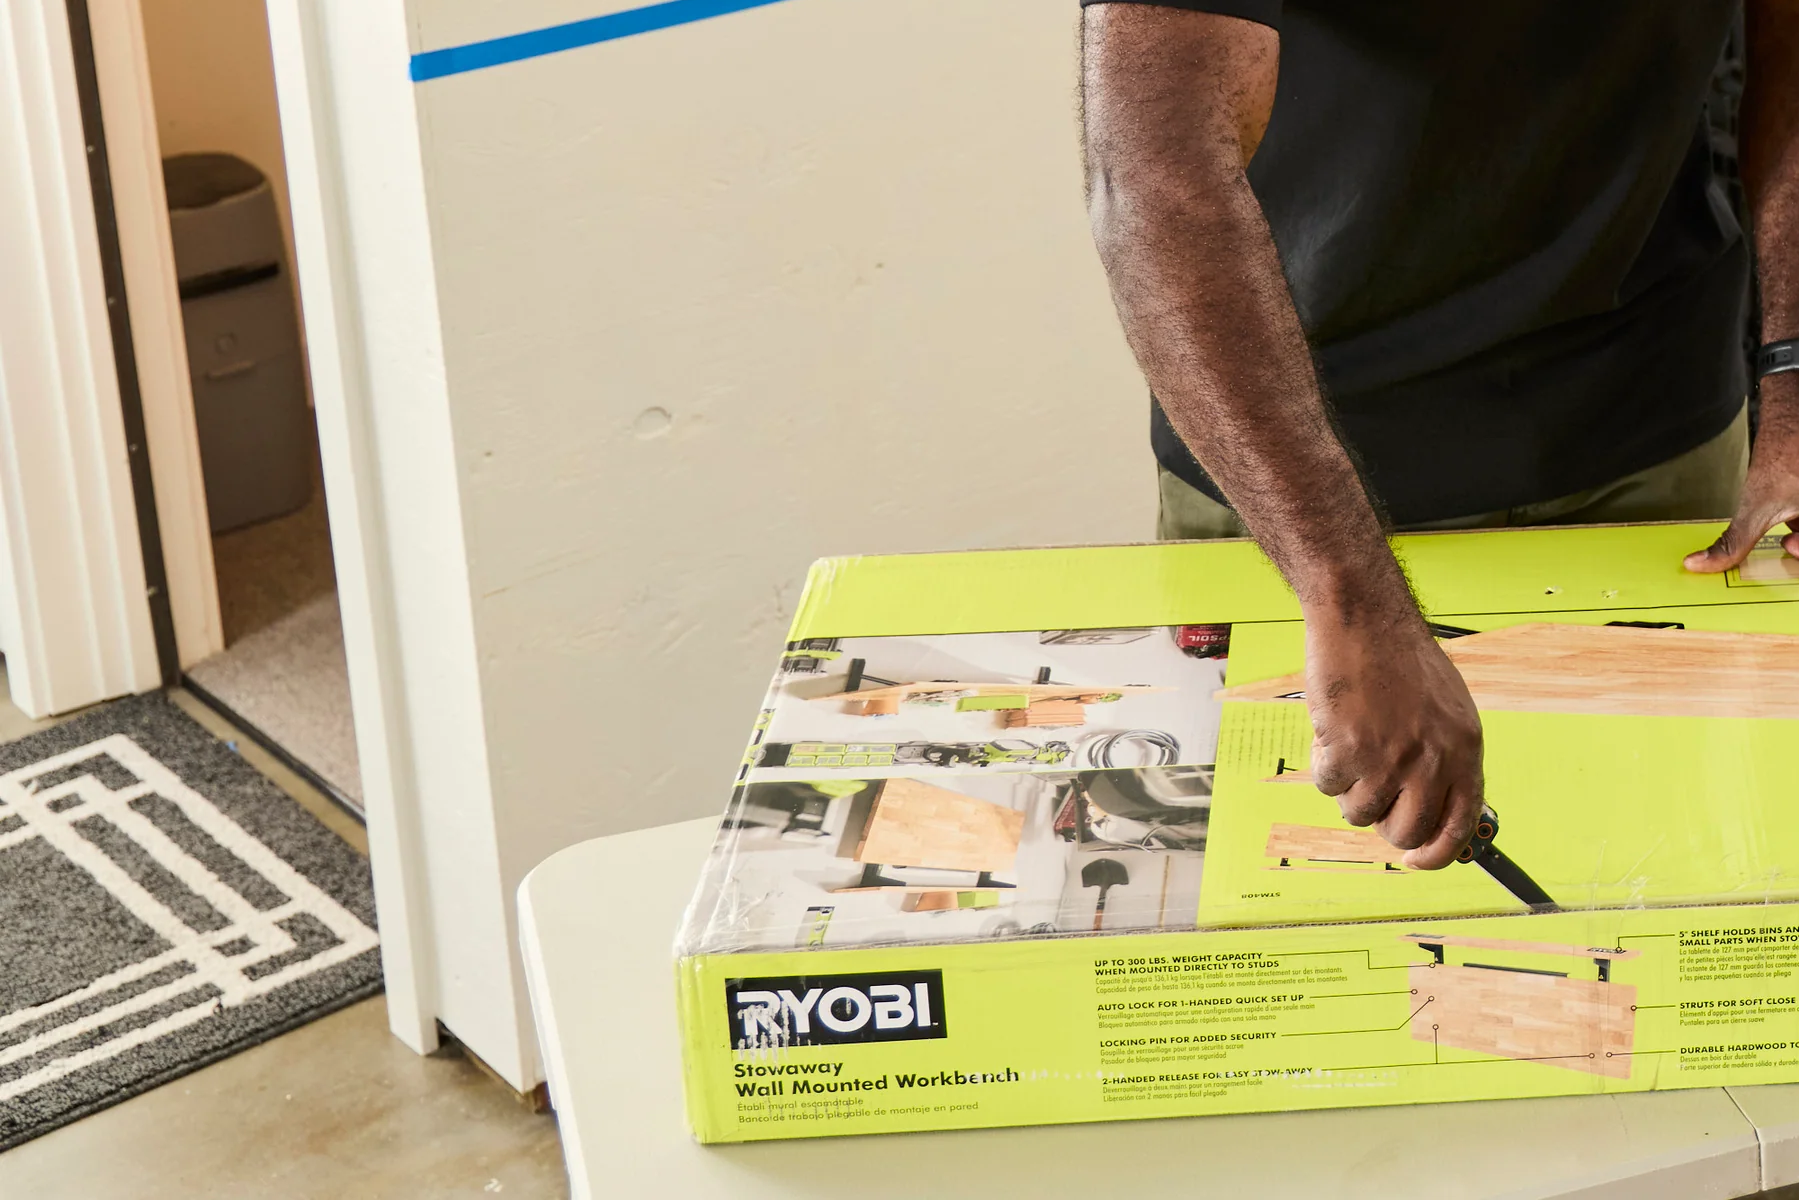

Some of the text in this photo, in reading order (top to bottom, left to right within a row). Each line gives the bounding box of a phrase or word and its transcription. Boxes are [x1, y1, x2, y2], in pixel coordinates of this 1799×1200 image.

[1722, 928, 1756, 936] HOLDS
[1171, 955, 1212, 963] WEIGHT
[1215, 952, 1263, 961] CAPACITY
[1129, 965, 1180, 973] MOUNTED
[1184, 963, 1228, 971] DIRECTLY
[1248, 960, 1279, 968] STUDS
[1180, 998, 1232, 1006] 1-HANDED
[1739, 998, 1762, 1006] SOFT
[736, 983, 931, 1036] RYOBI
[1100, 1038, 1146, 1047] LOCKING
[1192, 1034, 1227, 1042] ADDED
[1230, 1032, 1276, 1040] SECURITY
[1680, 1045, 1724, 1053] DURABLE
[1727, 1042, 1786, 1051] HARDWOOD
[734, 1063, 842, 1077] Stowaway
[734, 1067, 1018, 1096] Wall Mounted Workbench
[1102, 1076, 1155, 1084] 2-HANDED
[1159, 1073, 1198, 1081] RELEASE
[1225, 1070, 1248, 1078] EASY
[889, 1106, 930, 1114] montaje
[949, 1102, 978, 1112] pared
